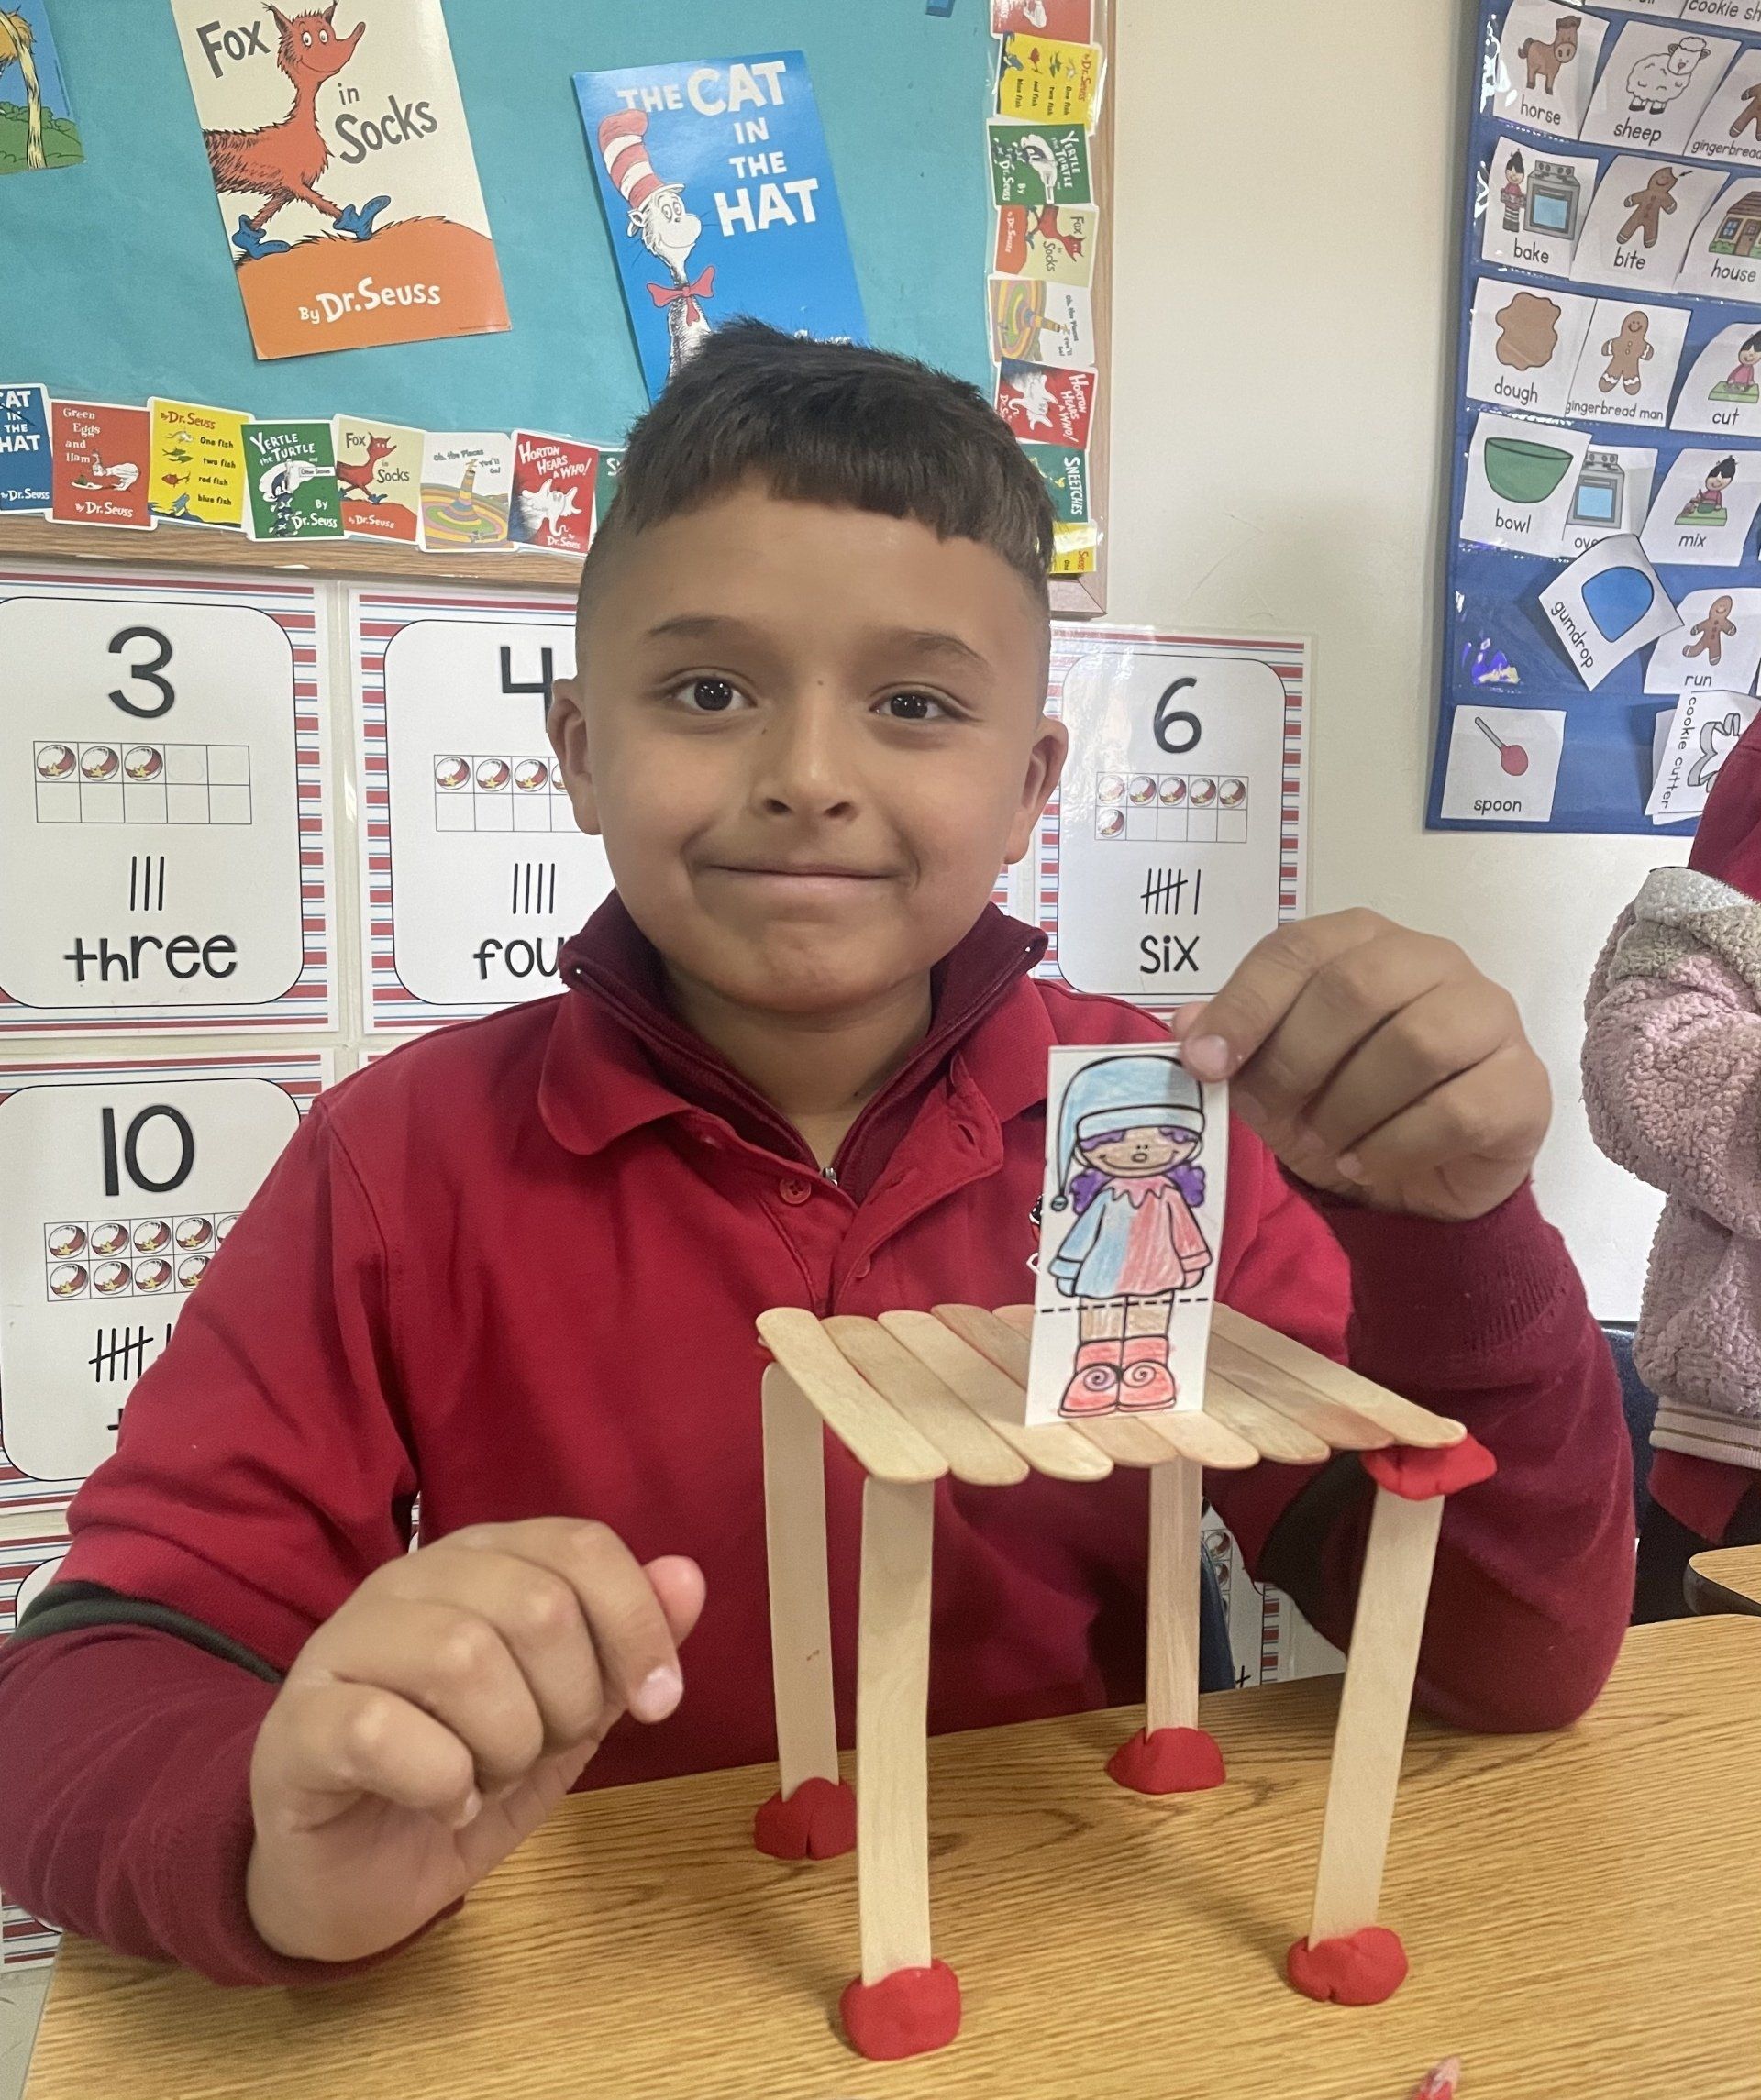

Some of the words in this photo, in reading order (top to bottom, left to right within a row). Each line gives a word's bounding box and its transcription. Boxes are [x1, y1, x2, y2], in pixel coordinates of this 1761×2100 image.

[1689, 0, 1738, 17] cookie
[1744, 0, 1761, 22] sh
[196, 20, 270, 78] Fox
[338, 83, 359, 104] in
[617, 83, 683, 113] THE
[687, 61, 786, 116] CAT
[1520, 94, 1561, 126] horse
[335, 96, 437, 164] Socks
[734, 117, 770, 144] IN
[1613, 117, 1662, 143] sheep
[729, 151, 787, 179] THE
[1017, 183, 1026, 194] By
[714, 178, 818, 237] HAT
[1070, 216, 1085, 234] Fox
[1043, 241, 1058, 271] Socks
[1513, 238, 1550, 264] bake
[1613, 247, 1645, 270] bite
[1711, 259, 1756, 282] house
[298, 307, 319, 325] By
[316, 290, 361, 323] Dr.
[358, 277, 441, 309] Seuss
[0, 390, 31, 410] AT
[1494, 376, 1538, 403] dough
[63, 407, 95, 419] Green
[167, 410, 185, 424] Dr.
[187, 412, 216, 429] Seuss
[1565, 401, 1636, 418] gingerbread
[1640, 409, 1663, 421] man
[1711, 407, 1740, 426] cut
[4, 424, 28, 433] THE
[72, 422, 101, 437] Eggs
[0, 434, 40, 453] HAT
[65, 440, 86, 449] and
[200, 437, 216, 447] One
[217, 438, 234, 449] fish
[249, 431, 299, 455] YERTLE
[346, 432, 367, 448] Fox
[66, 452, 91, 463] Ham
[203, 457, 218, 466] two
[220, 459, 236, 469] fish
[271, 443, 316, 462] TURTLE
[518, 441, 560, 464] HORTON
[376, 467, 410, 483] Socks
[537, 454, 568, 475] HEARS
[560, 458, 592, 479] WHO!
[199, 475, 211, 484] red
[213, 476, 228, 486] fish
[1064, 456, 1082, 516] SNEETCHES
[7, 489, 24, 501] Dr.
[24, 487, 50, 500] Seuss
[198, 493, 215, 503] blue
[216, 495, 232, 506] fish
[315, 498, 327, 510] By
[84, 501, 104, 514] Dr.
[104, 501, 133, 518] Seuss
[291, 514, 310, 530] Dr.
[310, 512, 338, 528] Seuss
[355, 514, 370, 525] Dr.
[369, 514, 395, 529] Seuss
[1495, 508, 1531, 533] bowl
[1574, 536, 1599, 550] ov
[1678, 533, 1707, 548] mix
[1077, 550, 1089, 571] Seuss
[1551, 601, 1594, 668] gumdrop
[107, 625, 175, 719] 3
[1685, 674, 1712, 687] run
[500, 646, 554, 734] 4
[1153, 676, 1202, 754] 6
[1678, 697, 1697, 750] cookie
[1661, 757, 1683, 809] cutter
[1473, 799, 1522, 815] spoon
[64, 934, 238, 983] three
[473, 935, 565, 980] fou
[102, 1104, 194, 1197] 10
